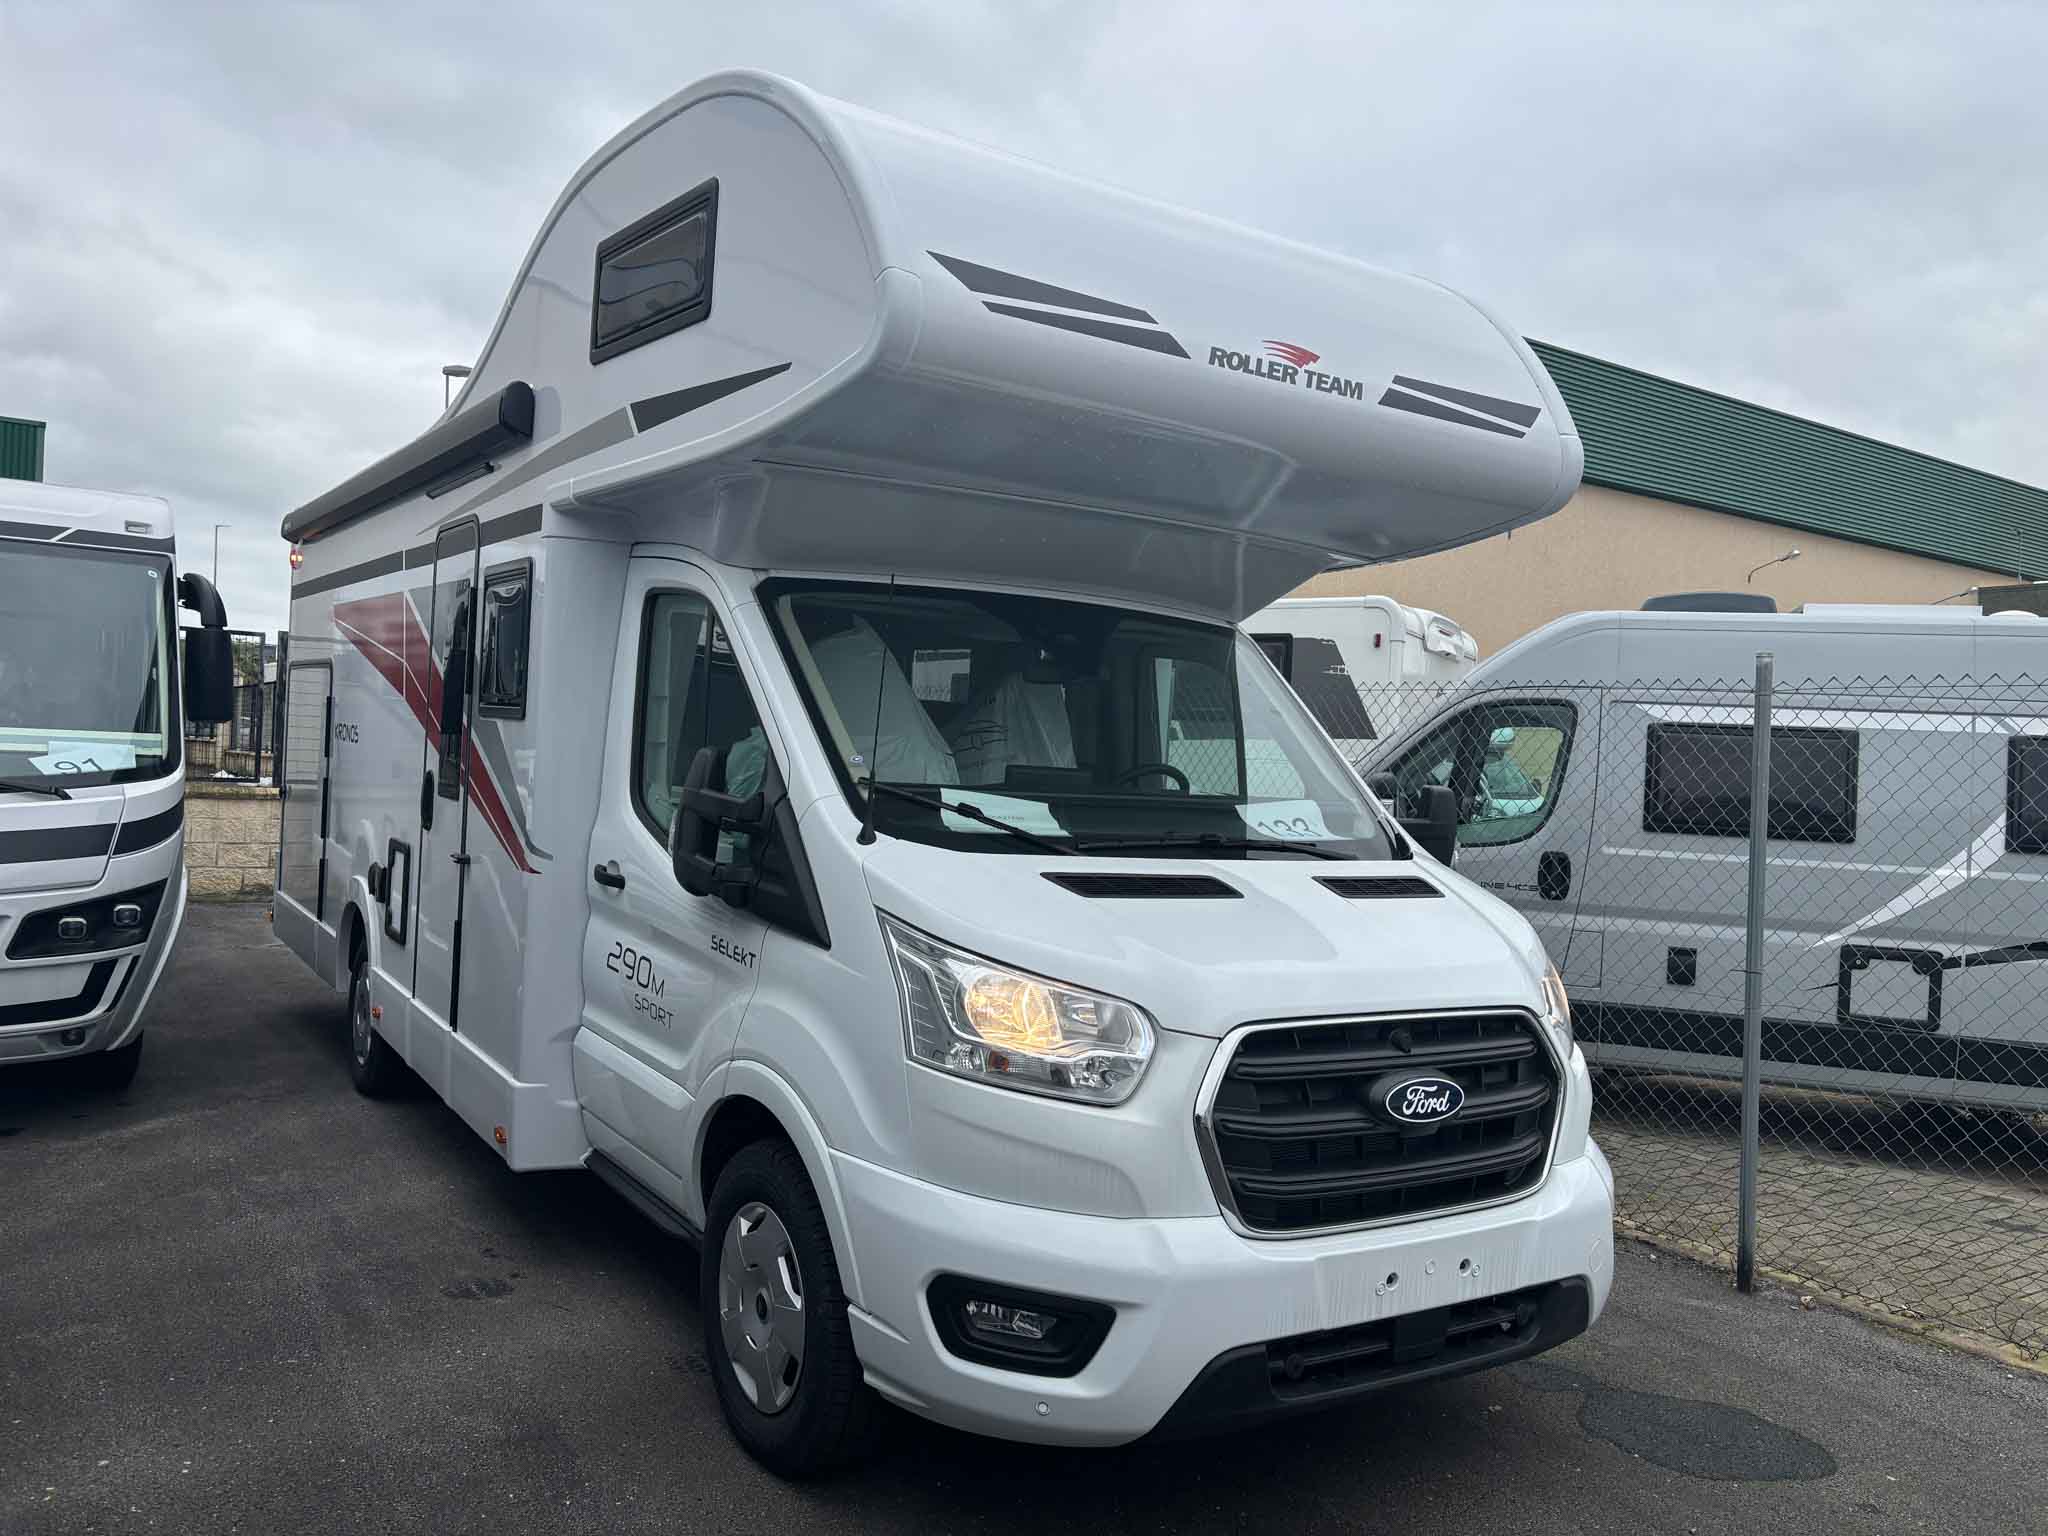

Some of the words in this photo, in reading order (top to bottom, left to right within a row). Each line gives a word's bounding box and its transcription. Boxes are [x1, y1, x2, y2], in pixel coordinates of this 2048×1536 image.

[1208, 346, 1299, 385] ROLLER
[1304, 369, 1363, 400] TEAM
[711, 934, 757, 969] SELEKT
[634, 993, 674, 1030] SPORT
[1402, 1085, 1450, 1115] Ford
